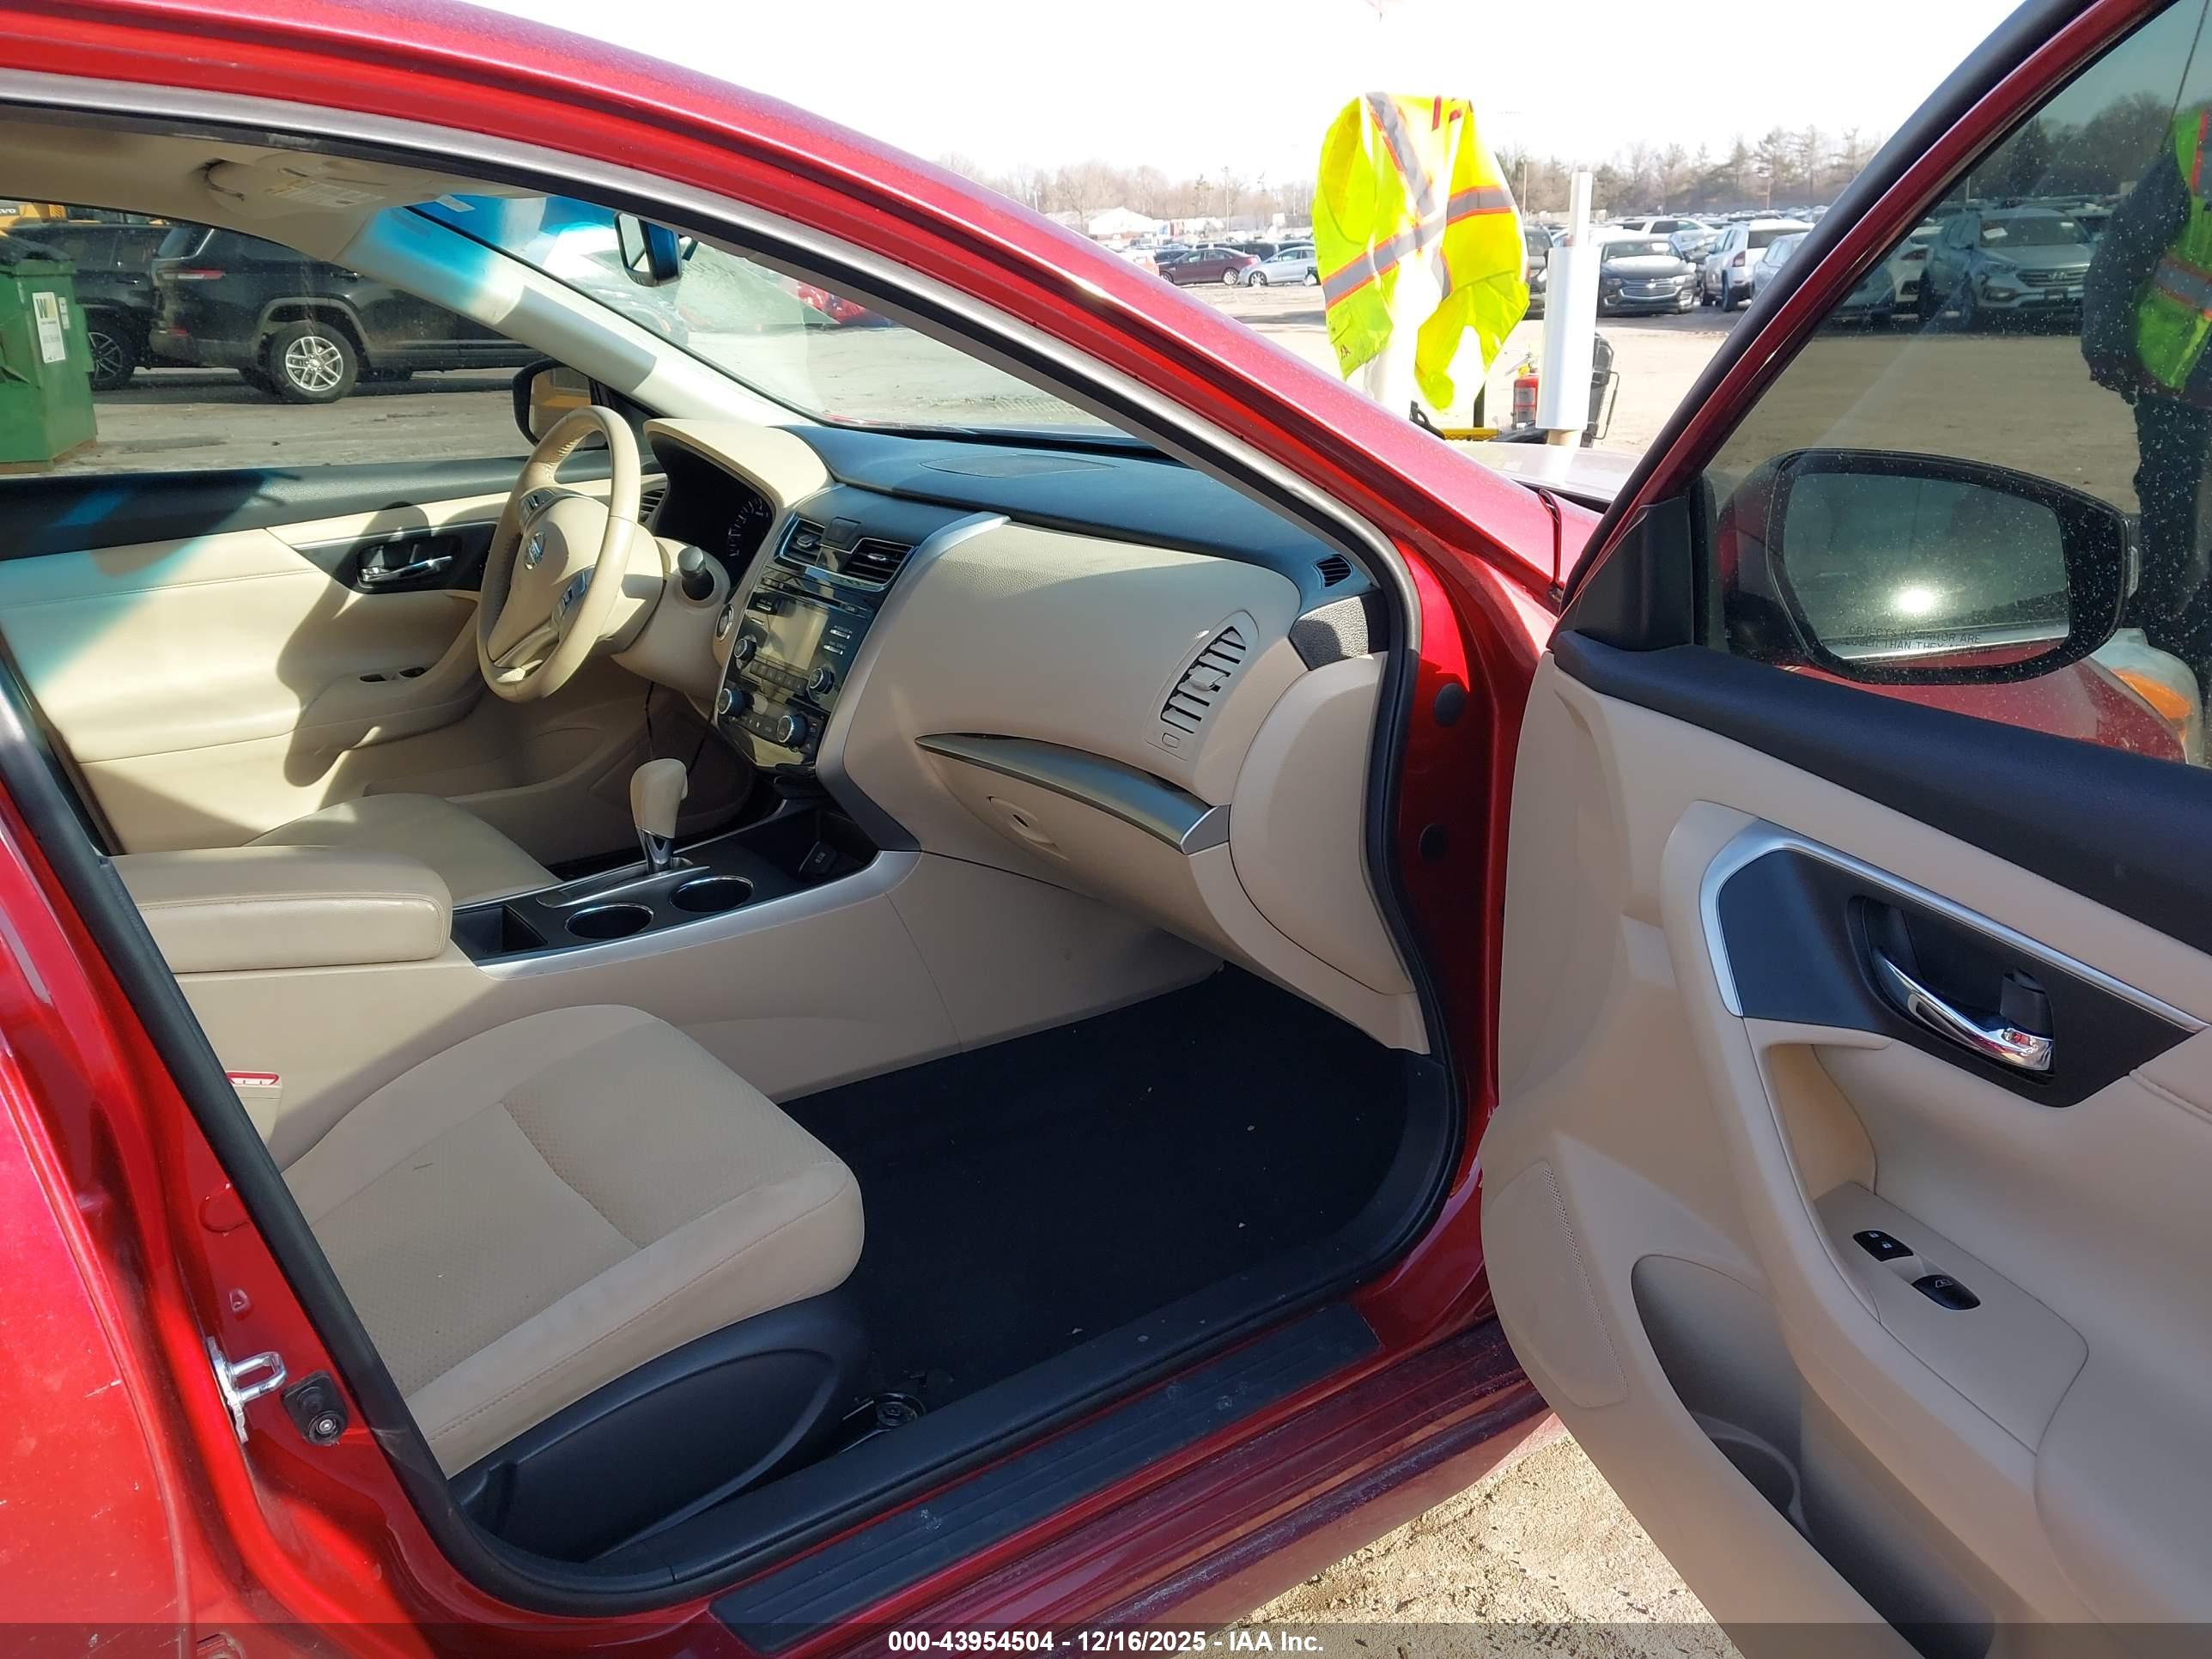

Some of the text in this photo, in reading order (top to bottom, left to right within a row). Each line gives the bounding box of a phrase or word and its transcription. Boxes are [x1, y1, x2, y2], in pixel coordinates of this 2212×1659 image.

[1849, 625, 1897, 637] OBJECTS
[1960, 632, 1980, 643] ARE
[1883, 638, 1911, 650] THAN
